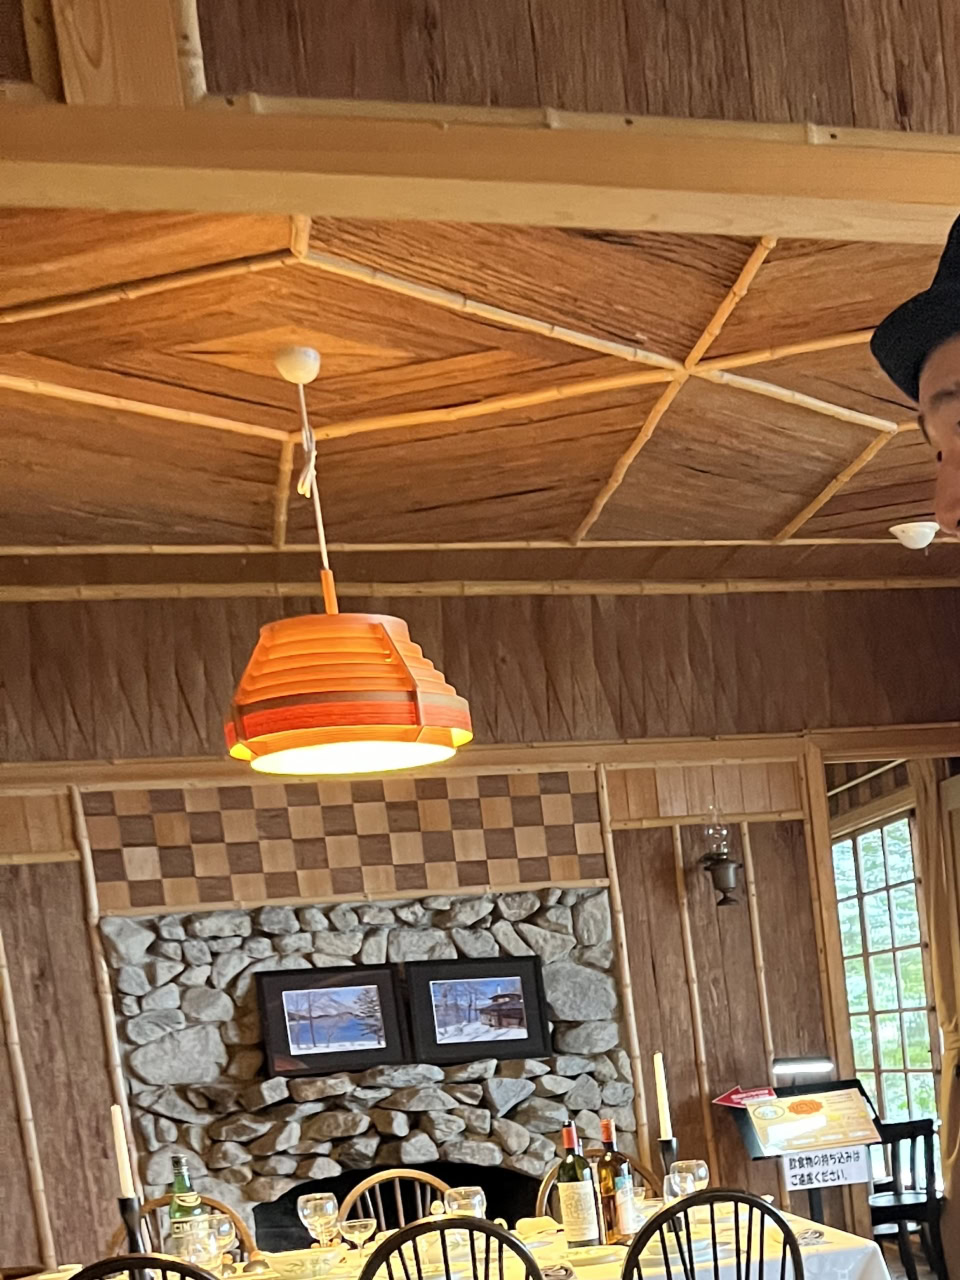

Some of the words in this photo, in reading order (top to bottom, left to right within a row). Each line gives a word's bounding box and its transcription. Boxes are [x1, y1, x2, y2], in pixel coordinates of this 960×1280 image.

[789, 1150, 860, 1170] 飲食物の持ち込みは
